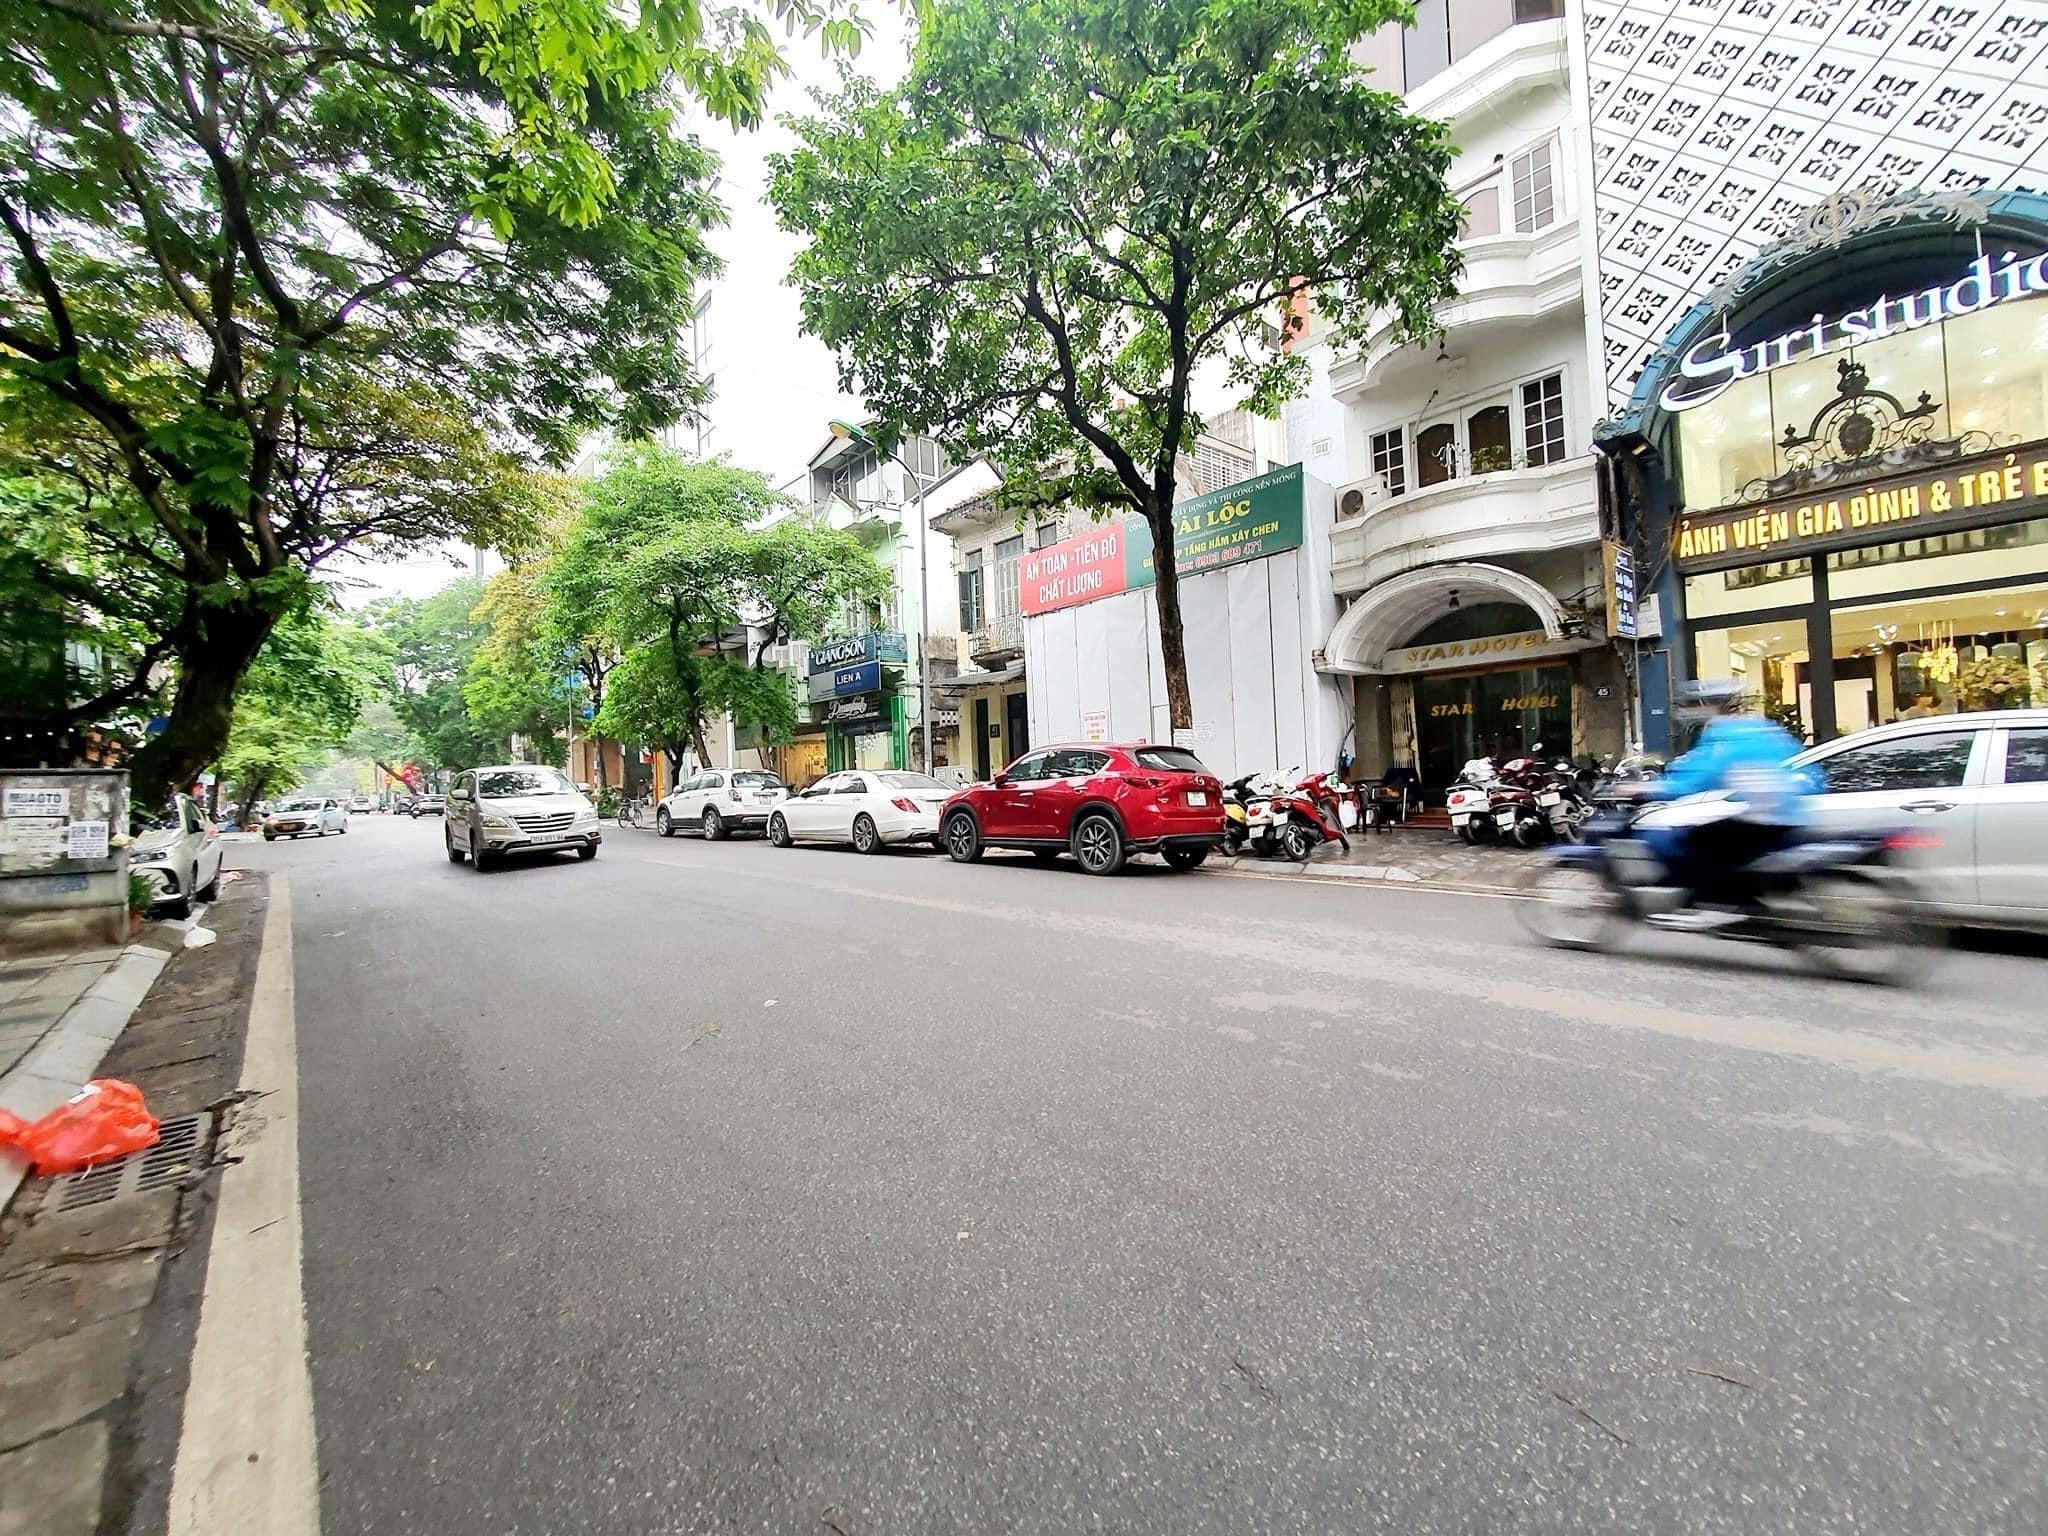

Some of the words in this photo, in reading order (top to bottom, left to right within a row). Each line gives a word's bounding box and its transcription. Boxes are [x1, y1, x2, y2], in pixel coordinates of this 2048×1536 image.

[1679, 519, 1727, 559] ẢNH
[1731, 509, 1790, 551] VIỆN
[1796, 501, 1844, 538] GIA
[1850, 487, 1921, 528] ĐÌNH
[1930, 480, 1953, 512] &
[1958, 453, 2024, 507] TRẺ
[1173, 515, 1202, 536] ÀI
[1206, 499, 1251, 526] LỘC
[1231, 527, 1250, 544] XÂY
[1252, 520, 1279, 538] CHEN
[1026, 562, 1039, 581] AN
[1407, 644, 1465, 663] STAR
[1430, 702, 1474, 717] STAR
